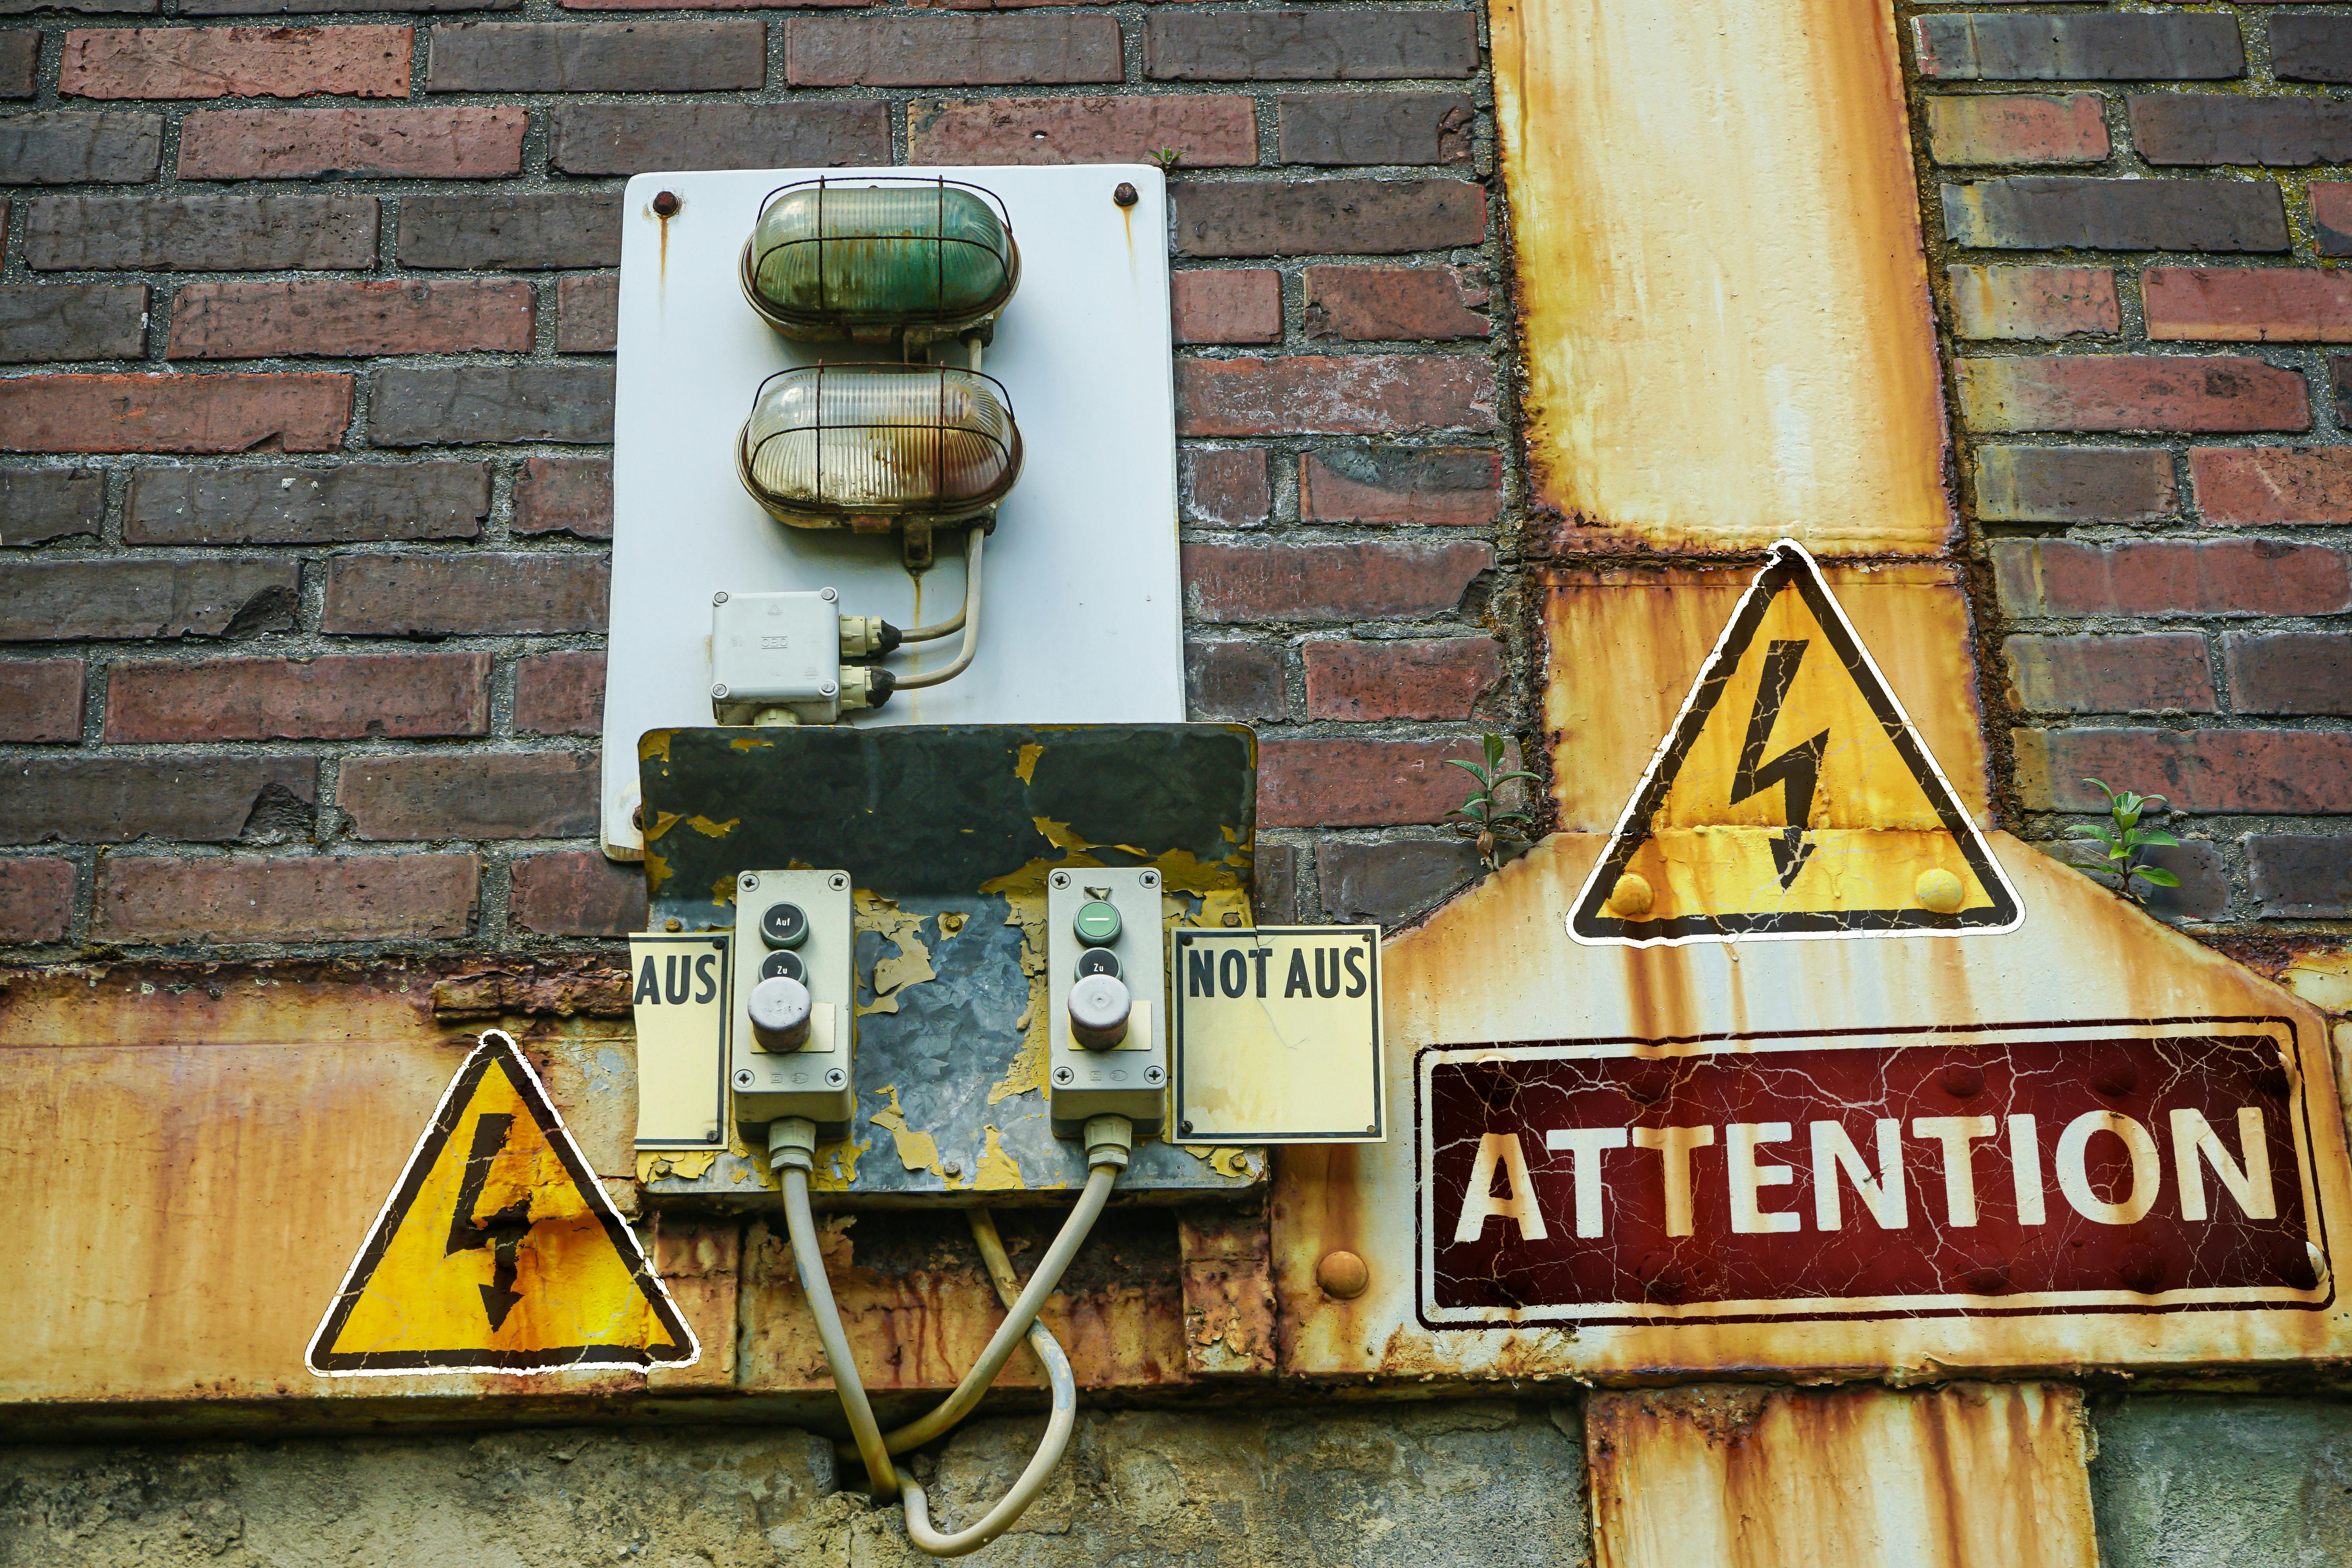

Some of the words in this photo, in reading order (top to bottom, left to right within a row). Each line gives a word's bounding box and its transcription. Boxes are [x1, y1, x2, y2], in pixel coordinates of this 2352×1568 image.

[761, 638, 788, 647] OBO
[776, 917, 790, 926] Auf
[777, 965, 788, 975] Zu
[1093, 963, 1103, 972] Zu
[1189, 948, 1273, 998] NOT
[1284, 947, 1367, 998] AUS
[633, 954, 717, 1005] AUS
[1454, 1107, 2278, 1243] ATTENTION
